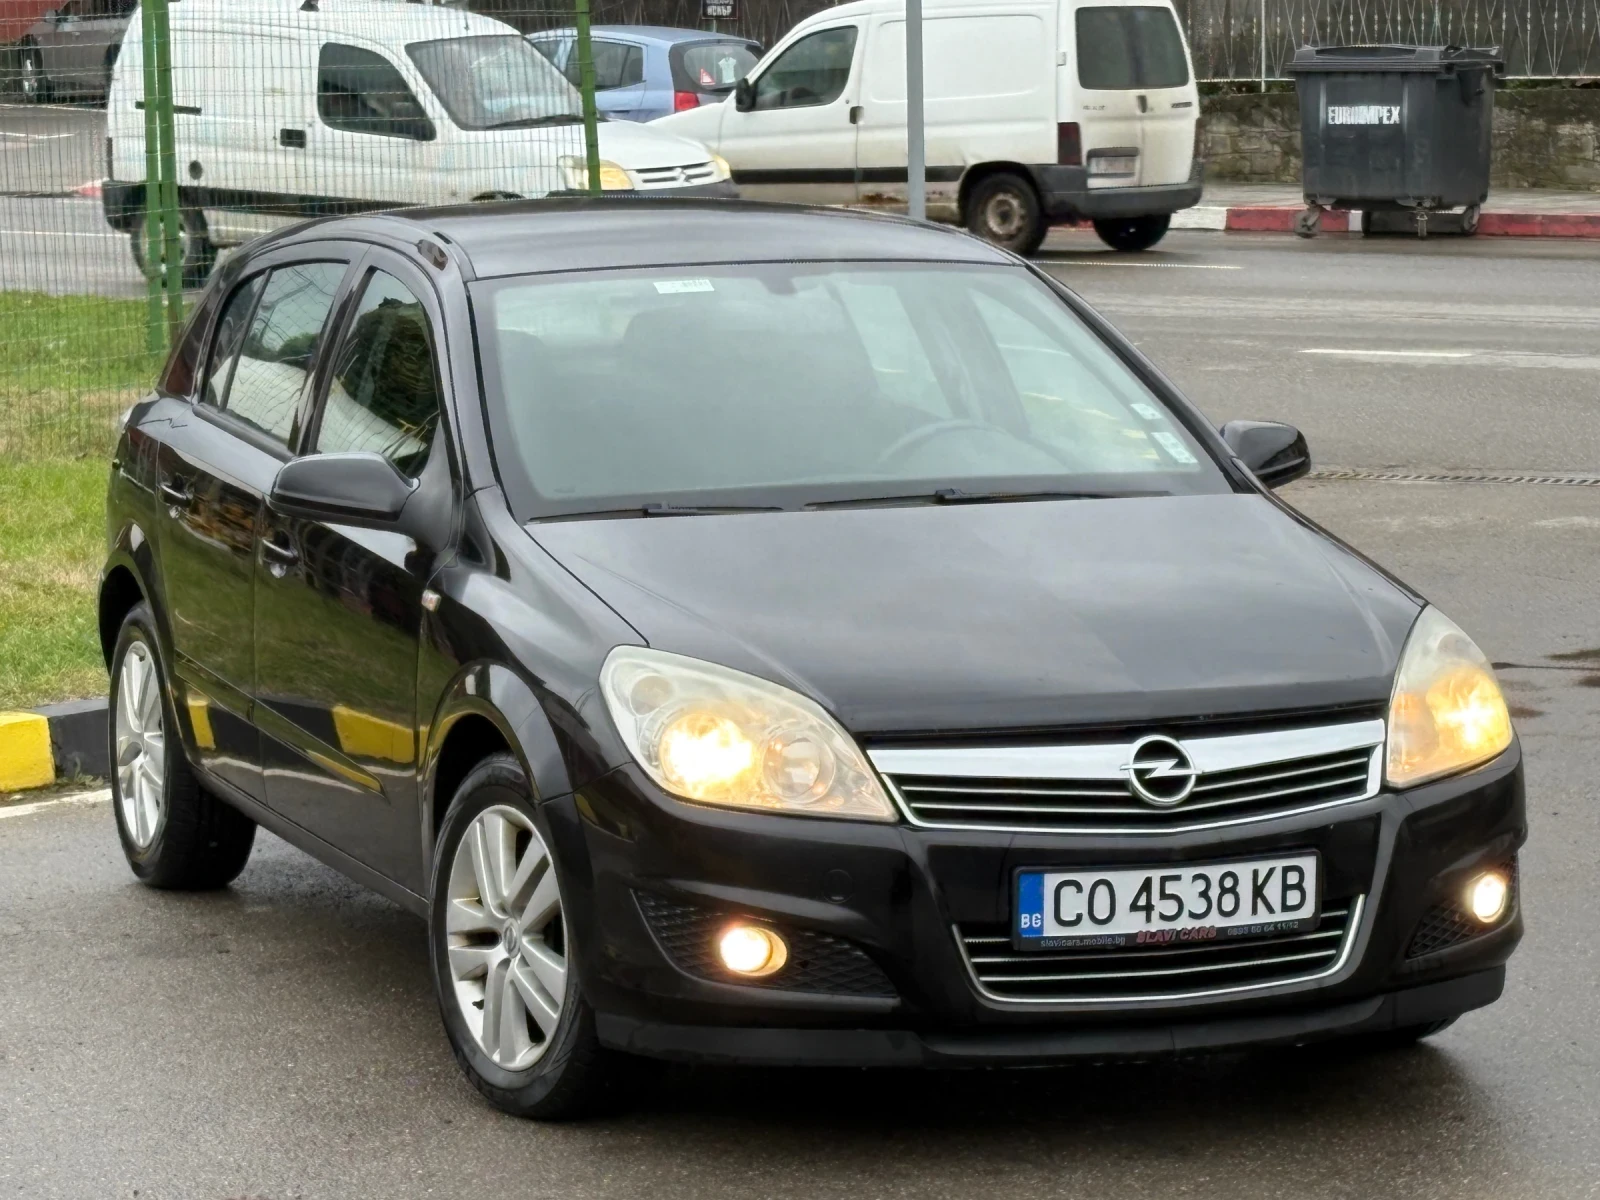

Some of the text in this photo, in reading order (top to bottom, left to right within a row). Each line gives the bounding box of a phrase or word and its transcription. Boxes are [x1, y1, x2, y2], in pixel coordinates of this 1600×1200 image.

[1129, 870, 1241, 924] 4538
[1020, 913, 1042, 929] BG
[1136, 925, 1217, 944] SLAVI CARS
